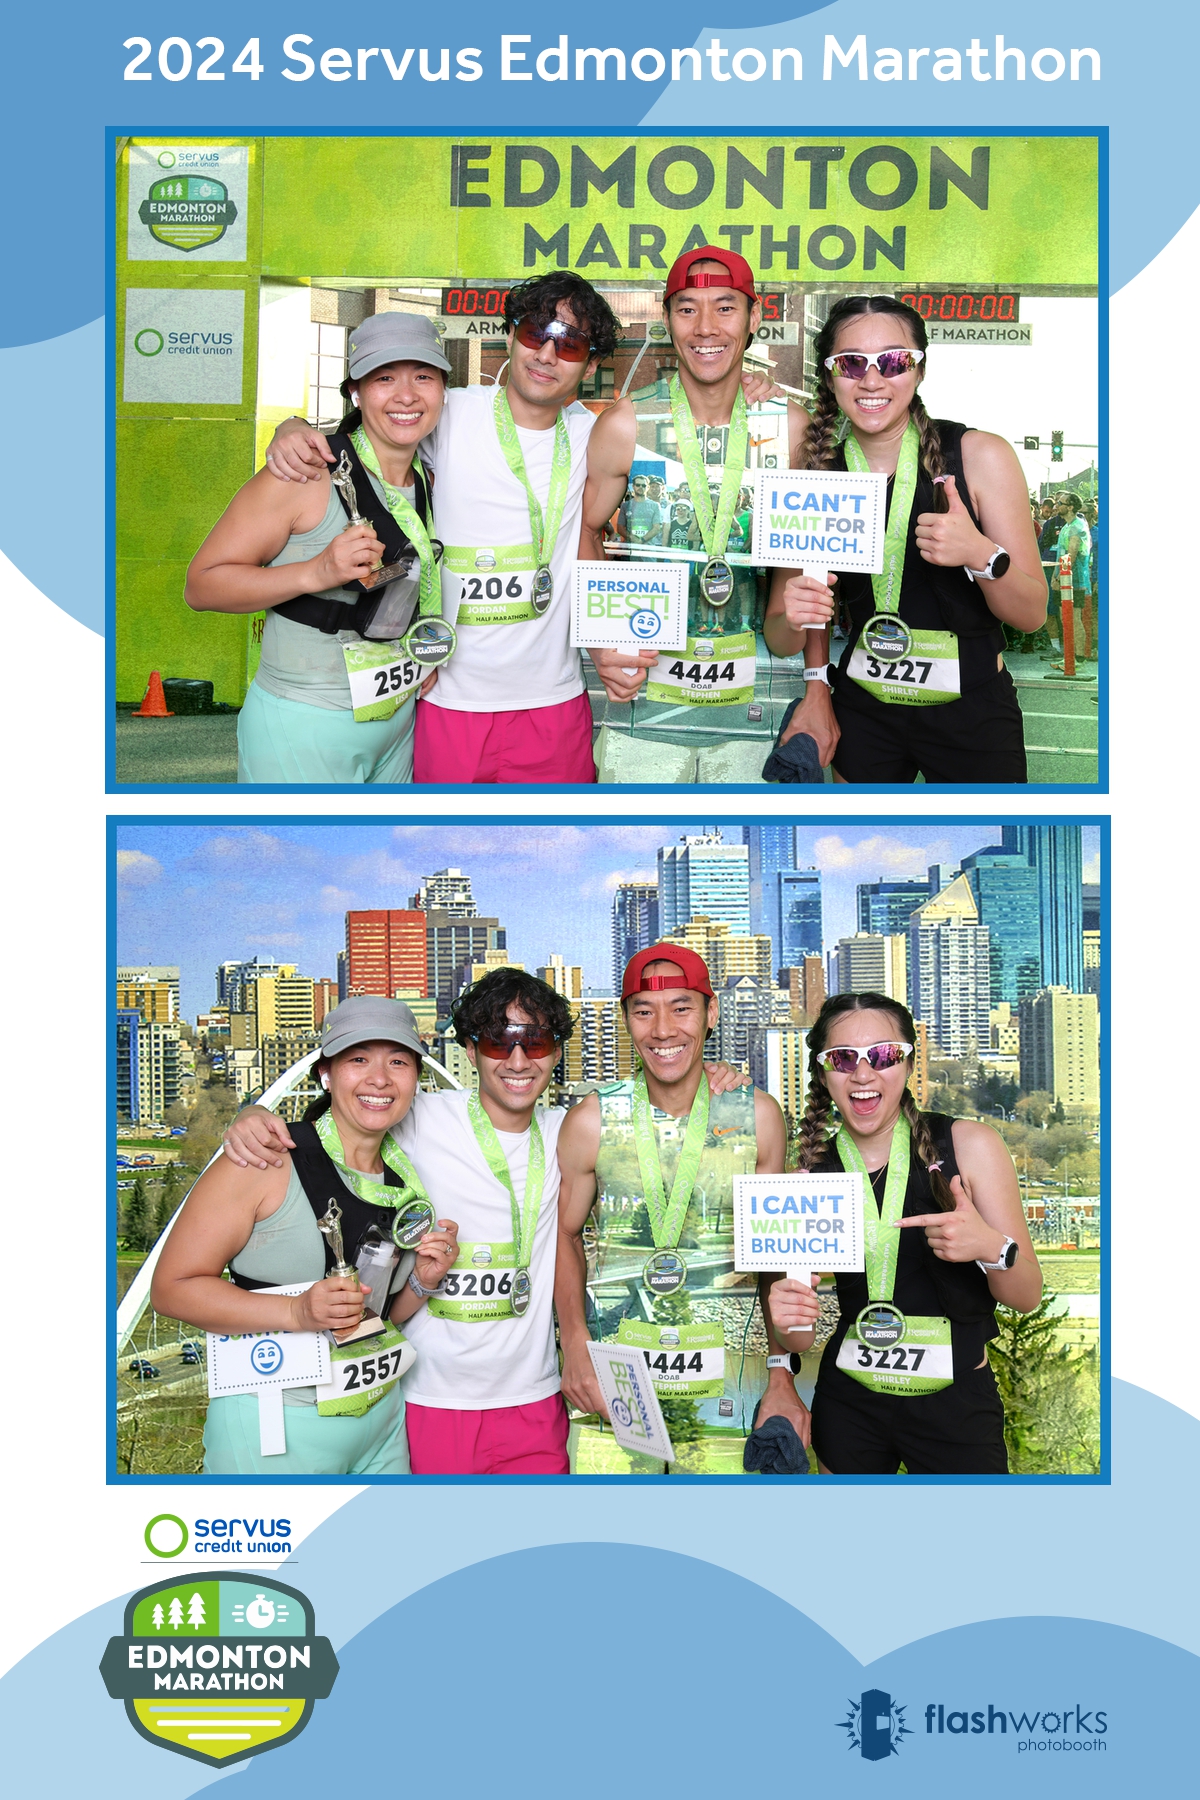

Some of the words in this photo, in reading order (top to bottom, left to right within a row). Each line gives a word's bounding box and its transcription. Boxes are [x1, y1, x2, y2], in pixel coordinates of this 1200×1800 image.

[178, 152, 220, 161] servus
[450, 145, 990, 210] EDMONTON
[149, 202, 227, 214] EDMONTON
[160, 214, 215, 222] MARATHON
[523, 223, 907, 271] MARATHON
[168, 331, 233, 345] servus
[943, 328, 1031, 341] MARATHON
[168, 345, 200, 355] credit
[203, 347, 233, 355] union
[771, 491, 777, 509] I
[769, 514, 822, 531] WAIT
[825, 517, 865, 534] FOR
[769, 533, 863, 554] BRUNCH.
[587, 580, 670, 593] PERSONAL
[467, 605, 507, 615] JORDAN
[587, 593, 669, 620] BEST!
[493, 613, 529, 621] MARATHON
[668, 661, 735, 683] 4444
[866, 655, 933, 684] 3227
[374, 660, 422, 697] 2557
[681, 689, 721, 698] STEPHEN
[882, 685, 919, 697] SHIRLEY
[706, 696, 740, 704] MARATHON
[751, 1196, 757, 1214] I
[750, 1219, 801, 1234] WAIT
[805, 1219, 845, 1234] FOR
[751, 1238, 844, 1254] BRUNCH.
[445, 1273, 512, 1296] 3206
[460, 1302, 497, 1311] JORDAN
[857, 1345, 926, 1372] 3227
[343, 1349, 402, 1391] 2557
[872, 1374, 911, 1386] SHIRLEY
[367, 1387, 384, 1400] LISA
[609, 1360, 648, 1439] BEST!
[625, 1363, 655, 1439] PERSONAL
